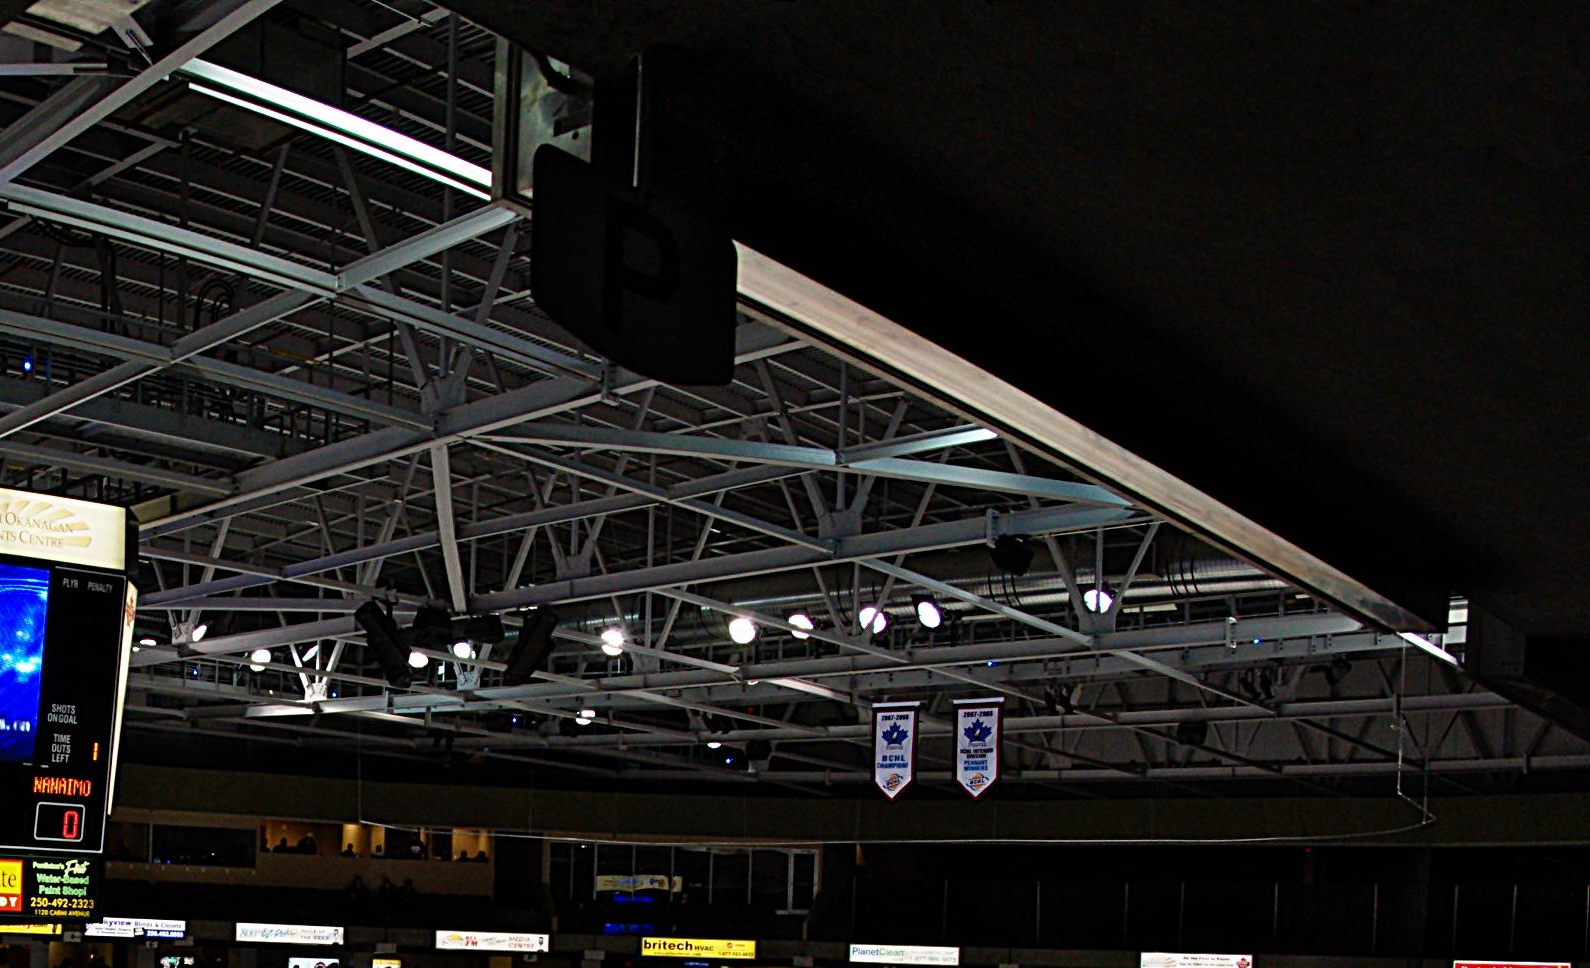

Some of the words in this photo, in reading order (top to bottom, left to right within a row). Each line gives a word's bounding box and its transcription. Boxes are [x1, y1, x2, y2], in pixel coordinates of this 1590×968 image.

[5, 512, 75, 534] OKANAGAN
[19, 531, 64, 549] CENTRE
[62, 578, 79, 589] PLYR
[87, 580, 114, 594] PENALTY
[51, 703, 76, 715] SHOTS
[53, 733, 71, 744] TIME
[51, 743, 71, 754] OUTS
[93, 742, 98, 761] 1
[51, 753, 69, 763] LEFT
[33, 777, 92, 797] NANAIMO
[63, 811, 78, 838] 0
[36, 873, 90, 884] Water-Based
[39, 885, 61, 895] Paint
[62, 886, 87, 897] Shop!
[30, 897, 95, 909] 250-492-2323
[643, 939, 693, 951] britech
[852, 946, 905, 956] PlanetClean
